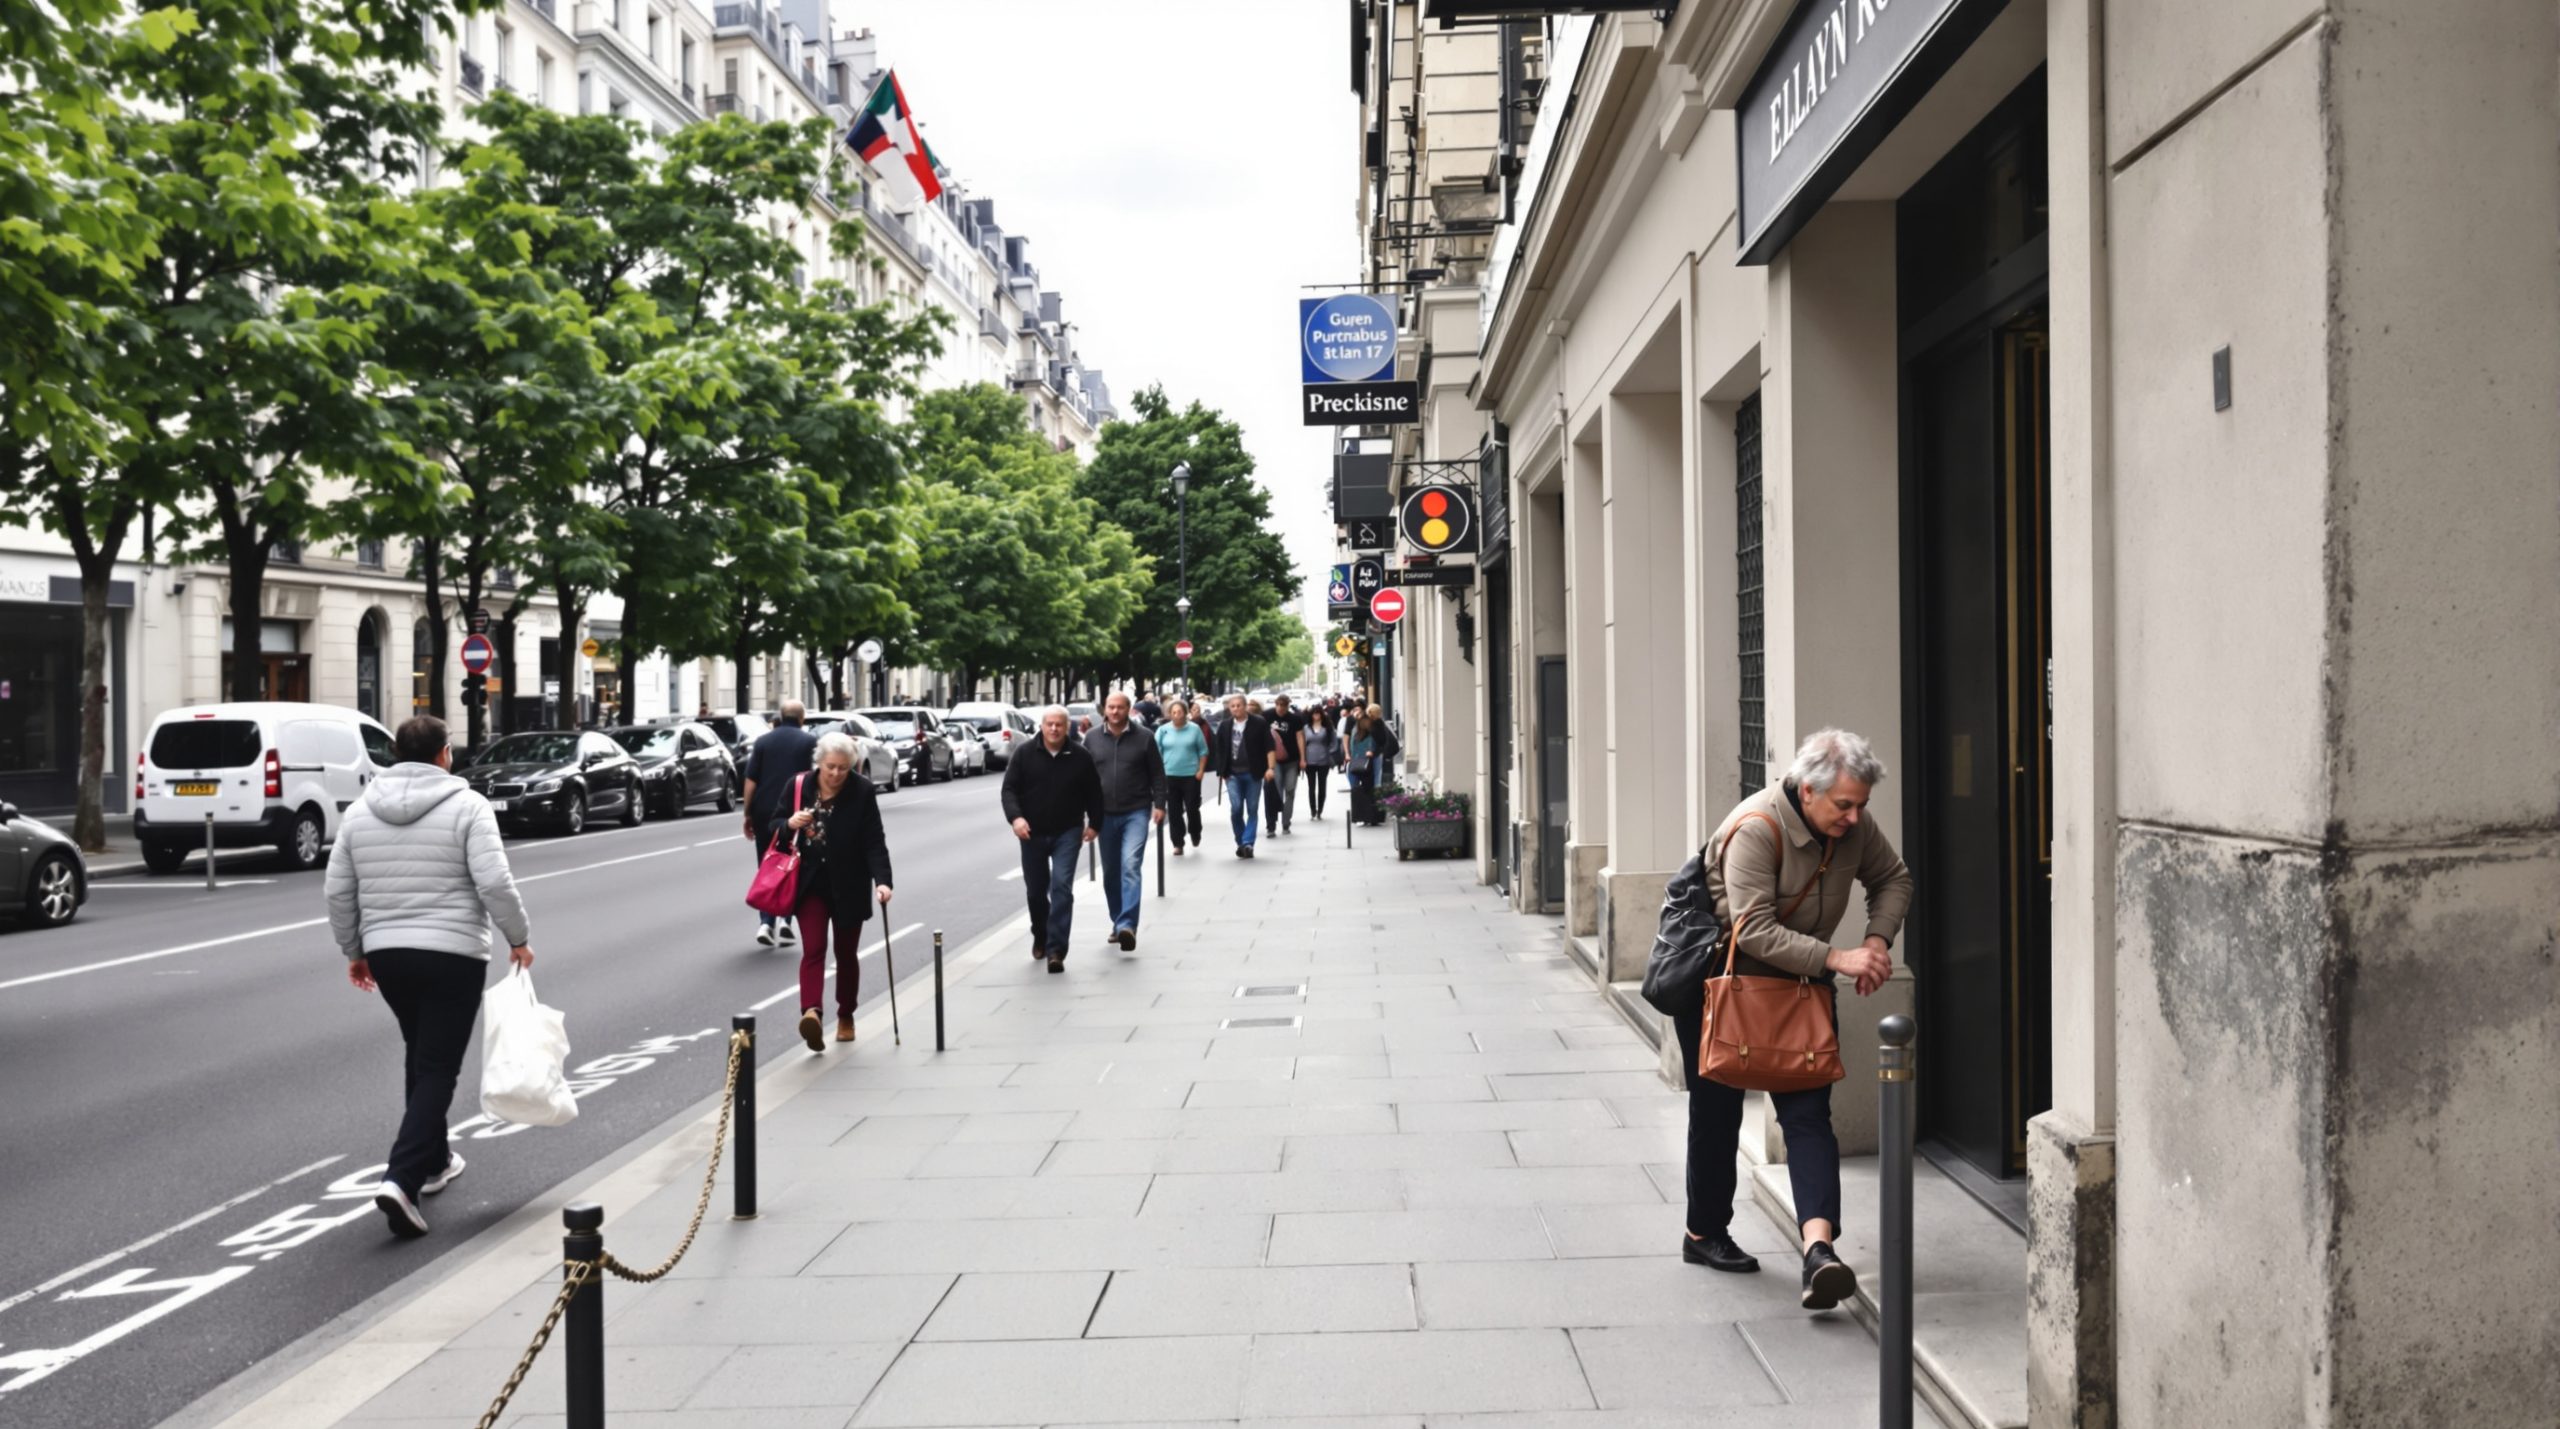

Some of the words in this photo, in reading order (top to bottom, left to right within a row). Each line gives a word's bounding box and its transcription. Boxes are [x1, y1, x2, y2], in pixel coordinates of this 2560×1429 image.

[1769, 0, 1847, 165] ELLAYN
[1366, 345, 1383, 359] 17
[1309, 391, 1408, 413] Preckisne
